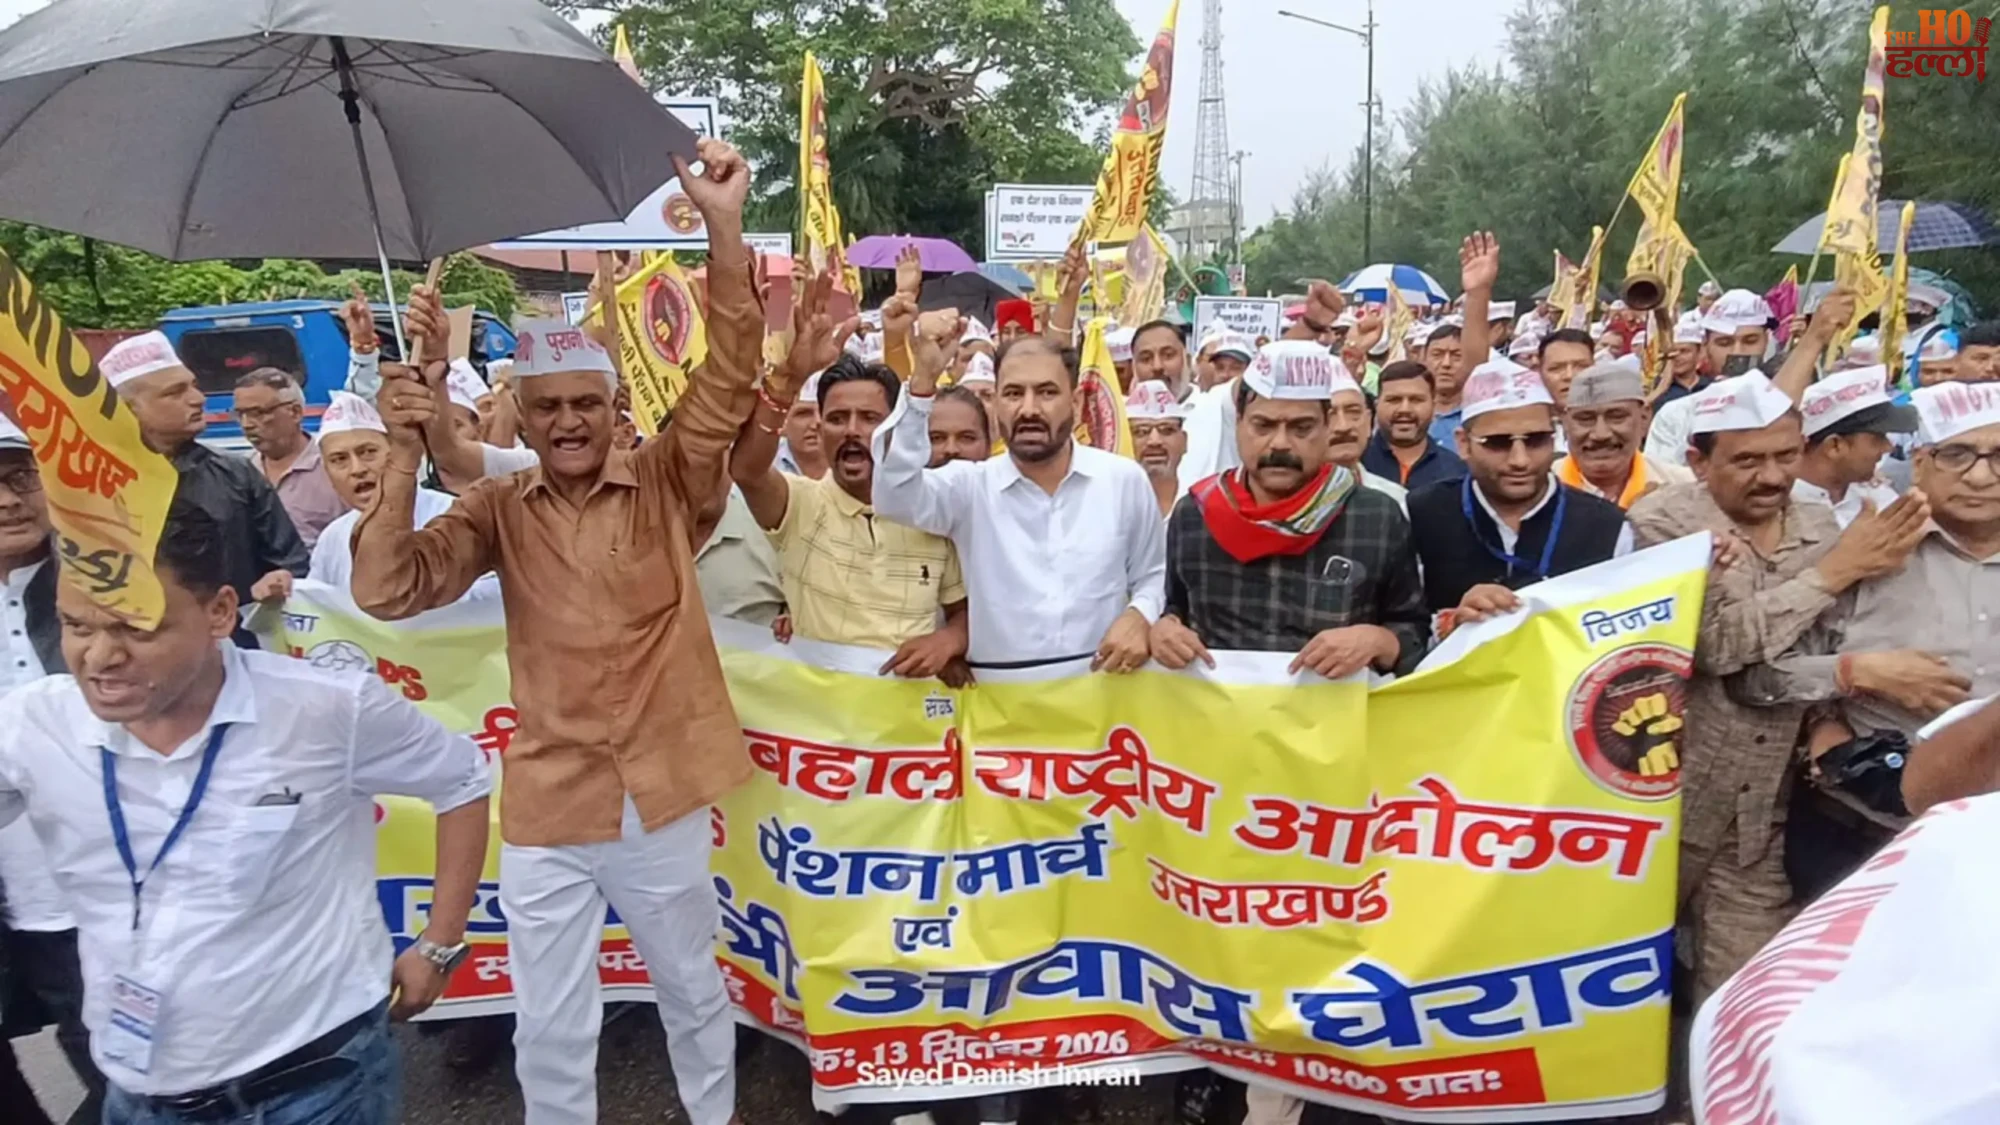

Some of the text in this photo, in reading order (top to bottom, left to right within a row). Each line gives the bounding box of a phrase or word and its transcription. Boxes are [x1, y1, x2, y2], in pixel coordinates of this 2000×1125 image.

[1582, 597, 1675, 643] विजय
[974, 727, 1215, 832] राष्ट्रीय
[1235, 777, 1664, 877] आंदोलन
[954, 823, 1107, 894] मार्च
[1147, 857, 1389, 925] उत्तराखण्ड
[892, 905, 958, 952] एवं
[833, 940, 1252, 1042] आवास
[1293, 928, 1675, 1049] घेराव
[872, 1041, 908, 1066] 13
[1054, 1030, 1130, 1059] 2026
[1291, 1057, 1388, 1095] 10:00
